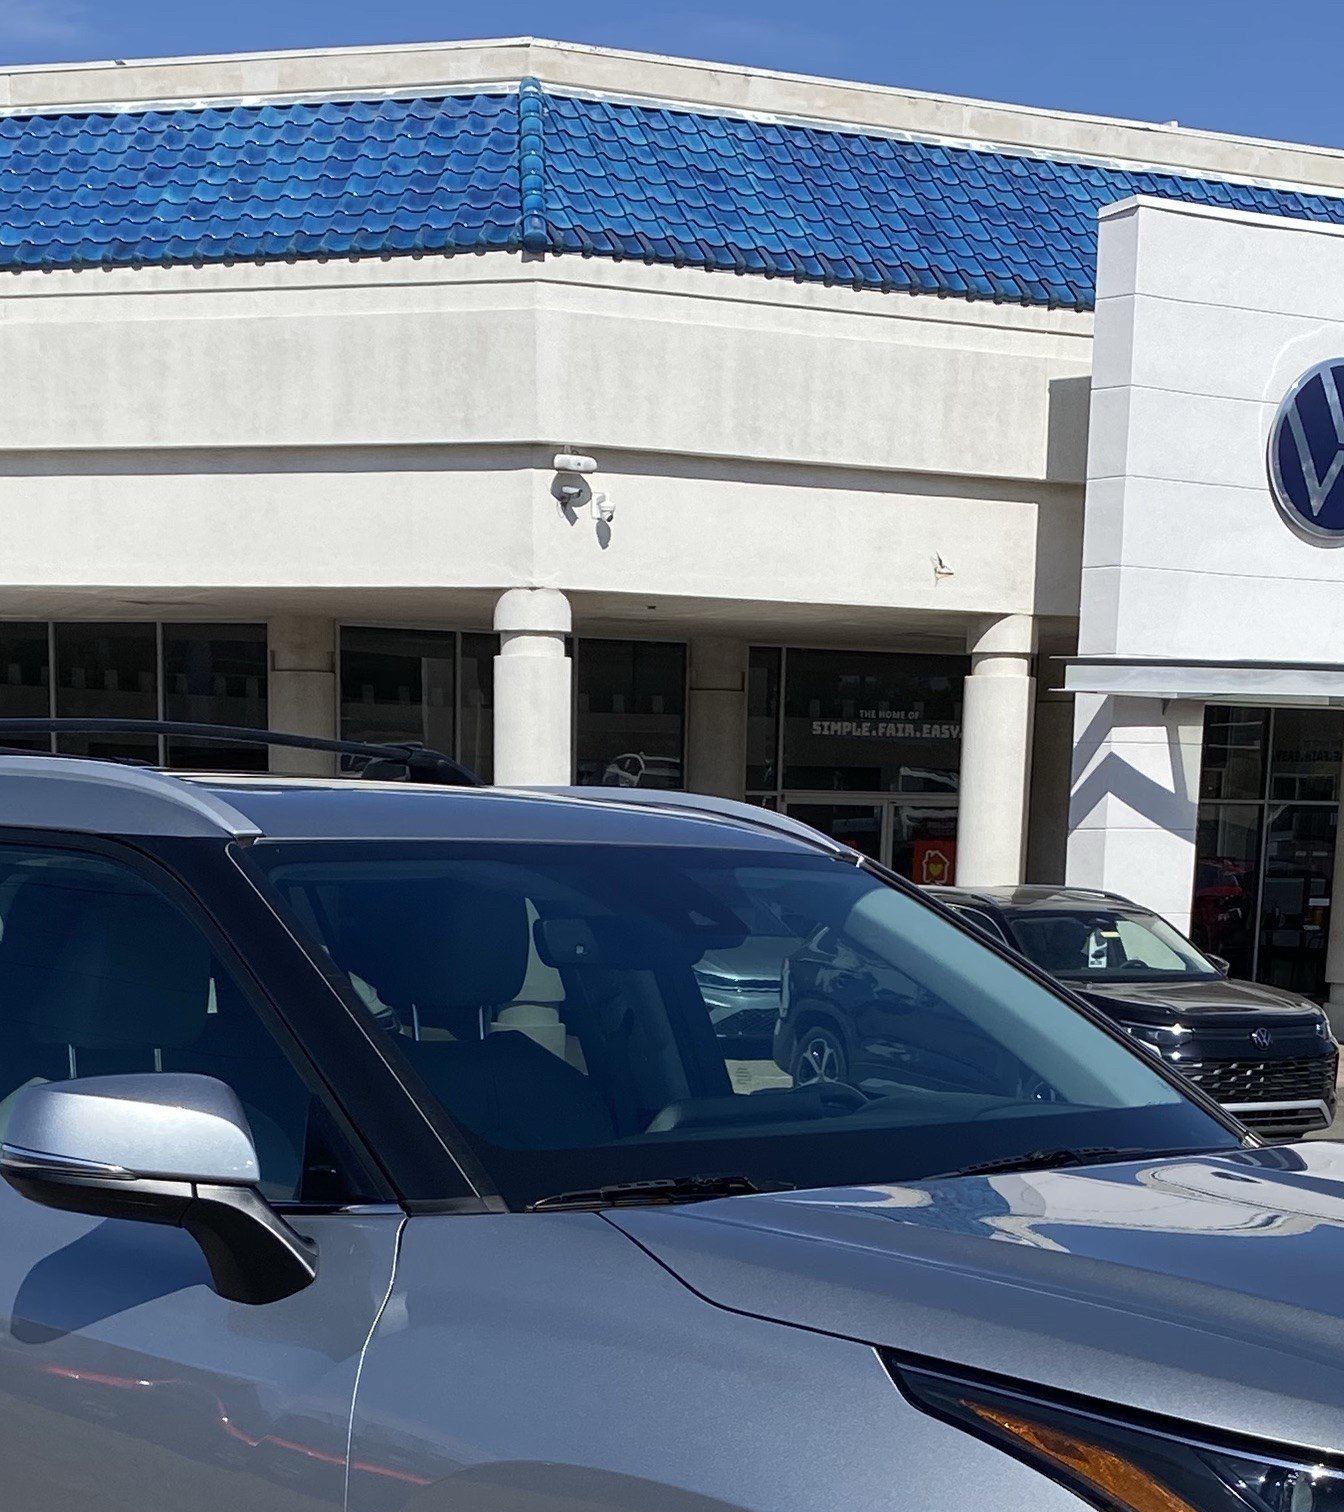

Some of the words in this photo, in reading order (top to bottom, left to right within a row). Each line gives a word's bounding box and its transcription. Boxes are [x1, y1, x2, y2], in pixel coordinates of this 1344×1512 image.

[859, 709, 876, 719] THE
[878, 709, 905, 719] HOME
[908, 711, 920, 720] OF
